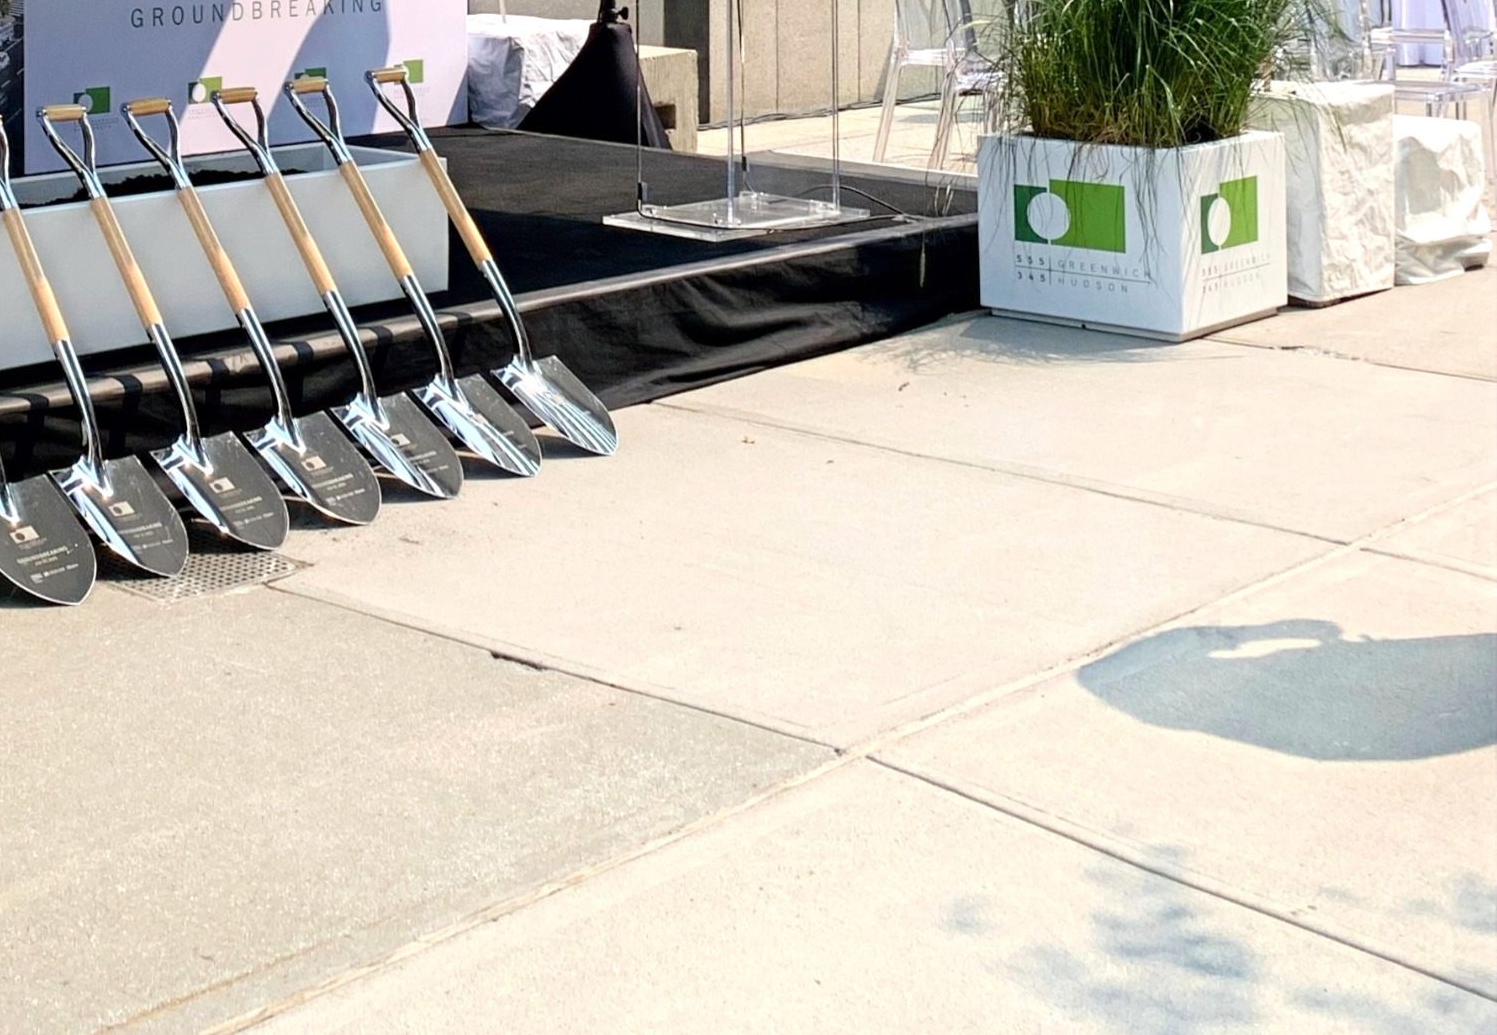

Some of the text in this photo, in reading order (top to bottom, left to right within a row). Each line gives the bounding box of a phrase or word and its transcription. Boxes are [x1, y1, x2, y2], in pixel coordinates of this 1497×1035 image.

[1016, 253, 1045, 266] 555
[1016, 271, 1129, 293] 345 HUDSON
